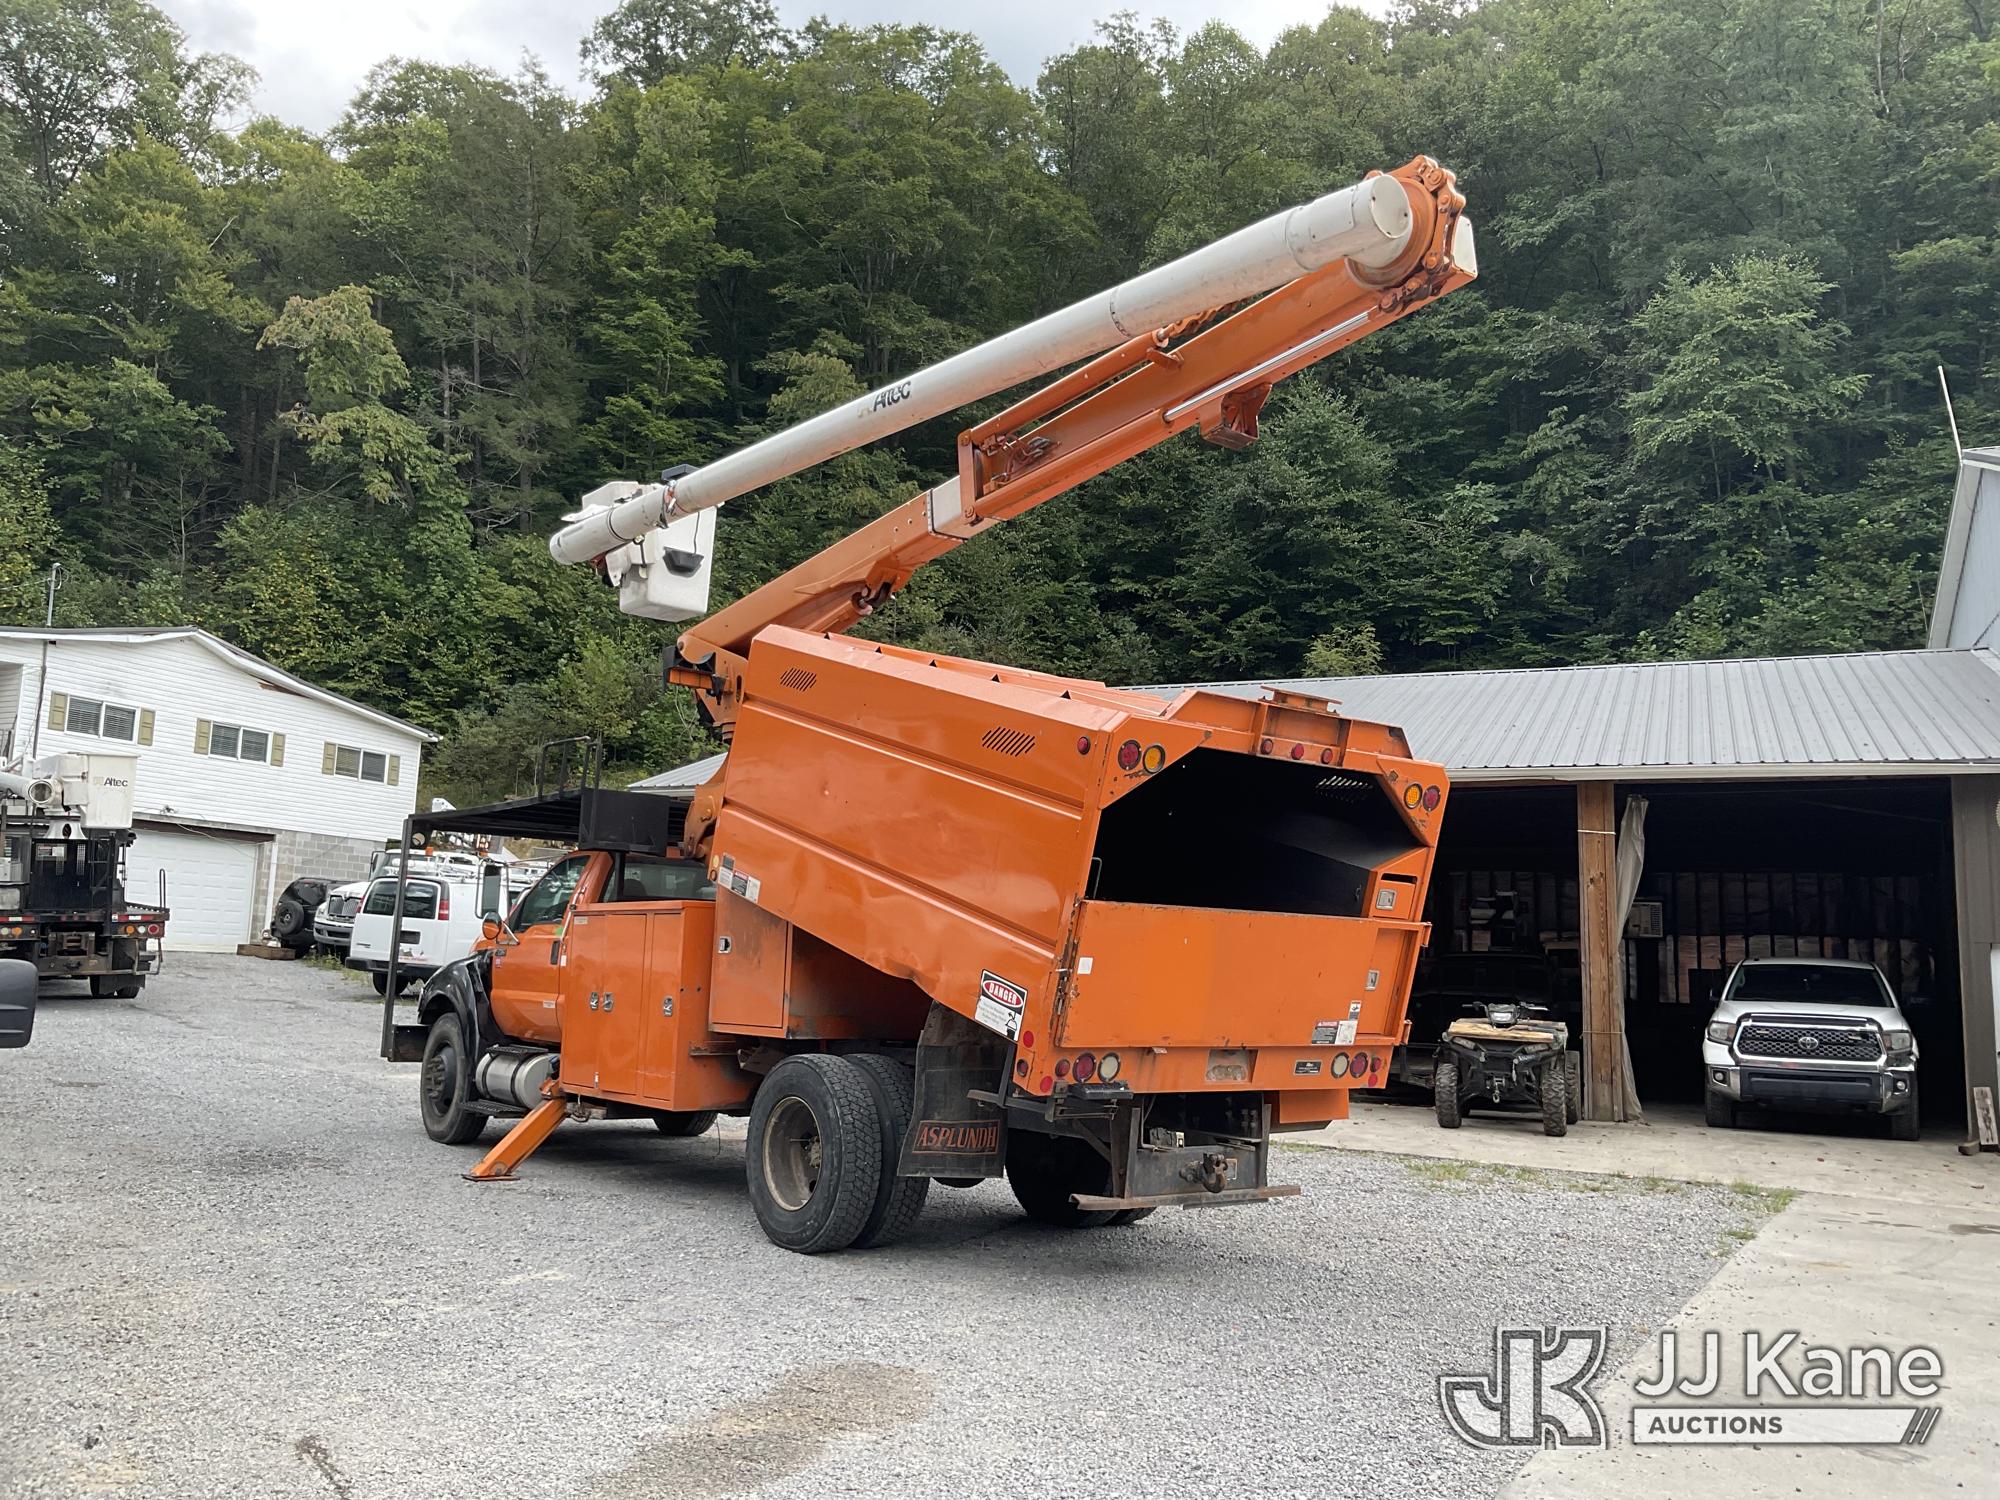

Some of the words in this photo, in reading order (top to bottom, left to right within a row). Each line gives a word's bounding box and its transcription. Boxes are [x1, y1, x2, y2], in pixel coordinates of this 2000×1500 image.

[873, 381, 912, 412] Altec
[103, 777, 129, 787] Altec
[988, 982, 1018, 1006] DANGER
[917, 1125, 998, 1150] ASPLUNDH
